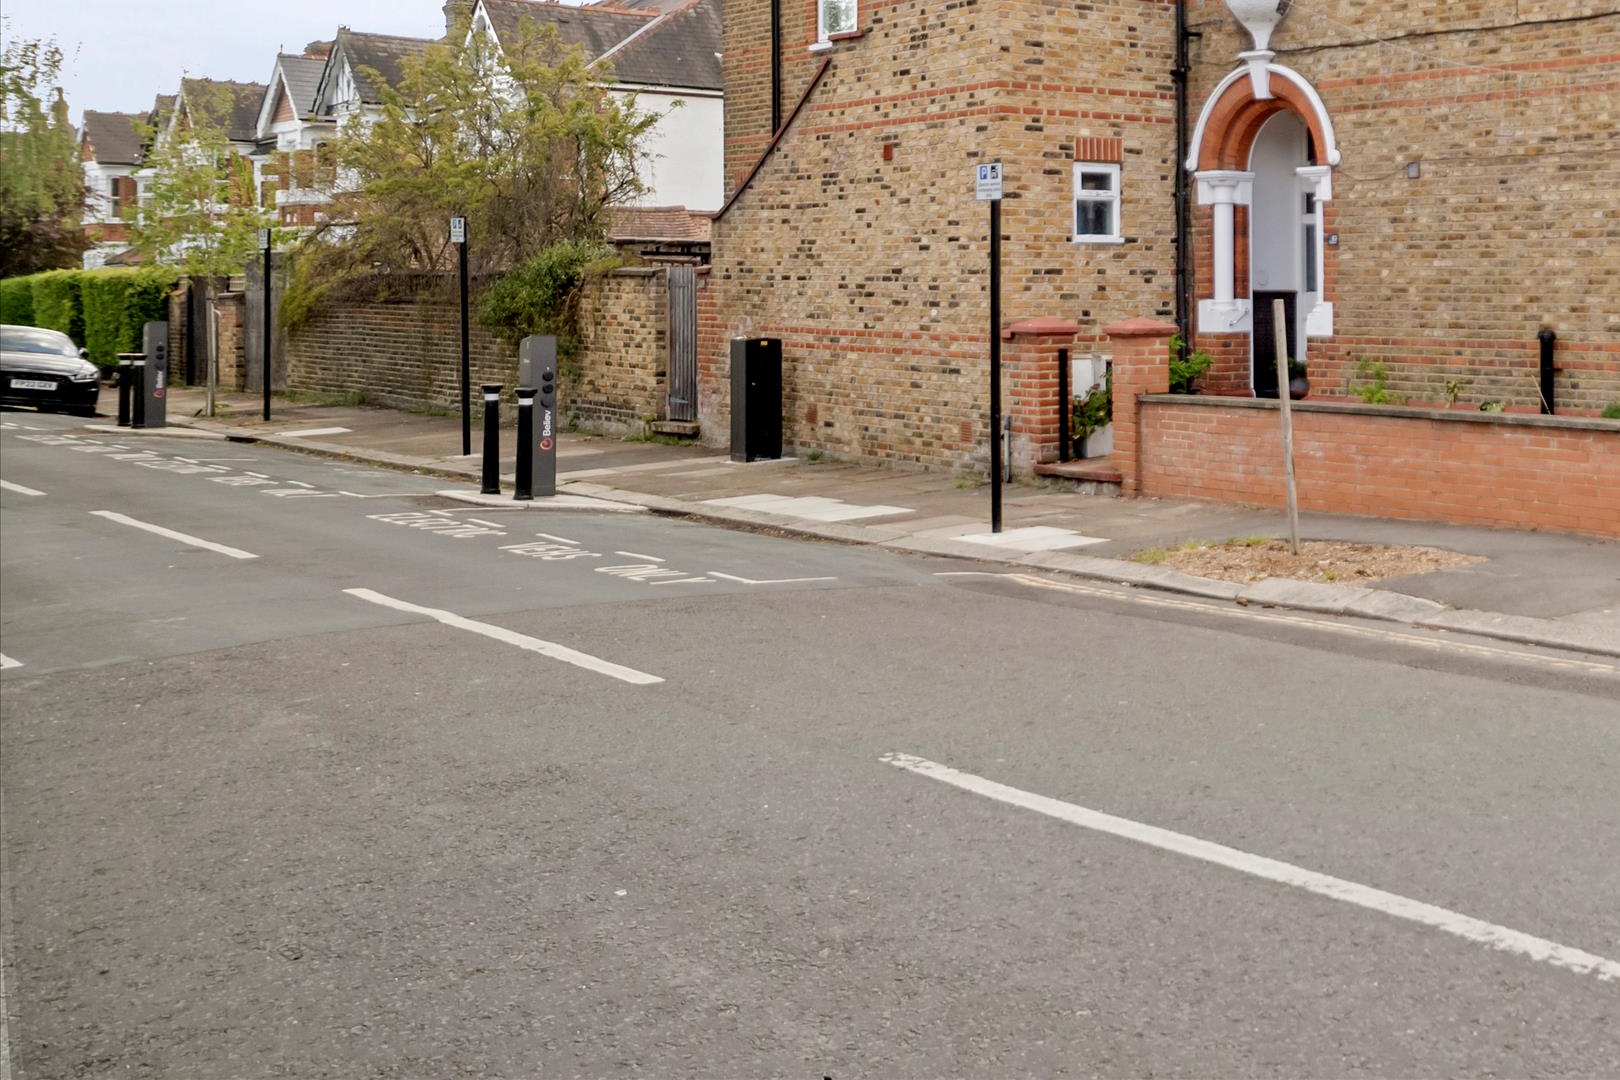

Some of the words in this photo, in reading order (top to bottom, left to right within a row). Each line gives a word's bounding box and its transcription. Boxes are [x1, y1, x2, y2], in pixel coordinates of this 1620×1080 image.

[543, 410, 551, 436] Believ
[366, 512, 507, 538] ELECTRIC
[497, 541, 602, 561] VEHS
[593, 564, 717, 585] ONLY
